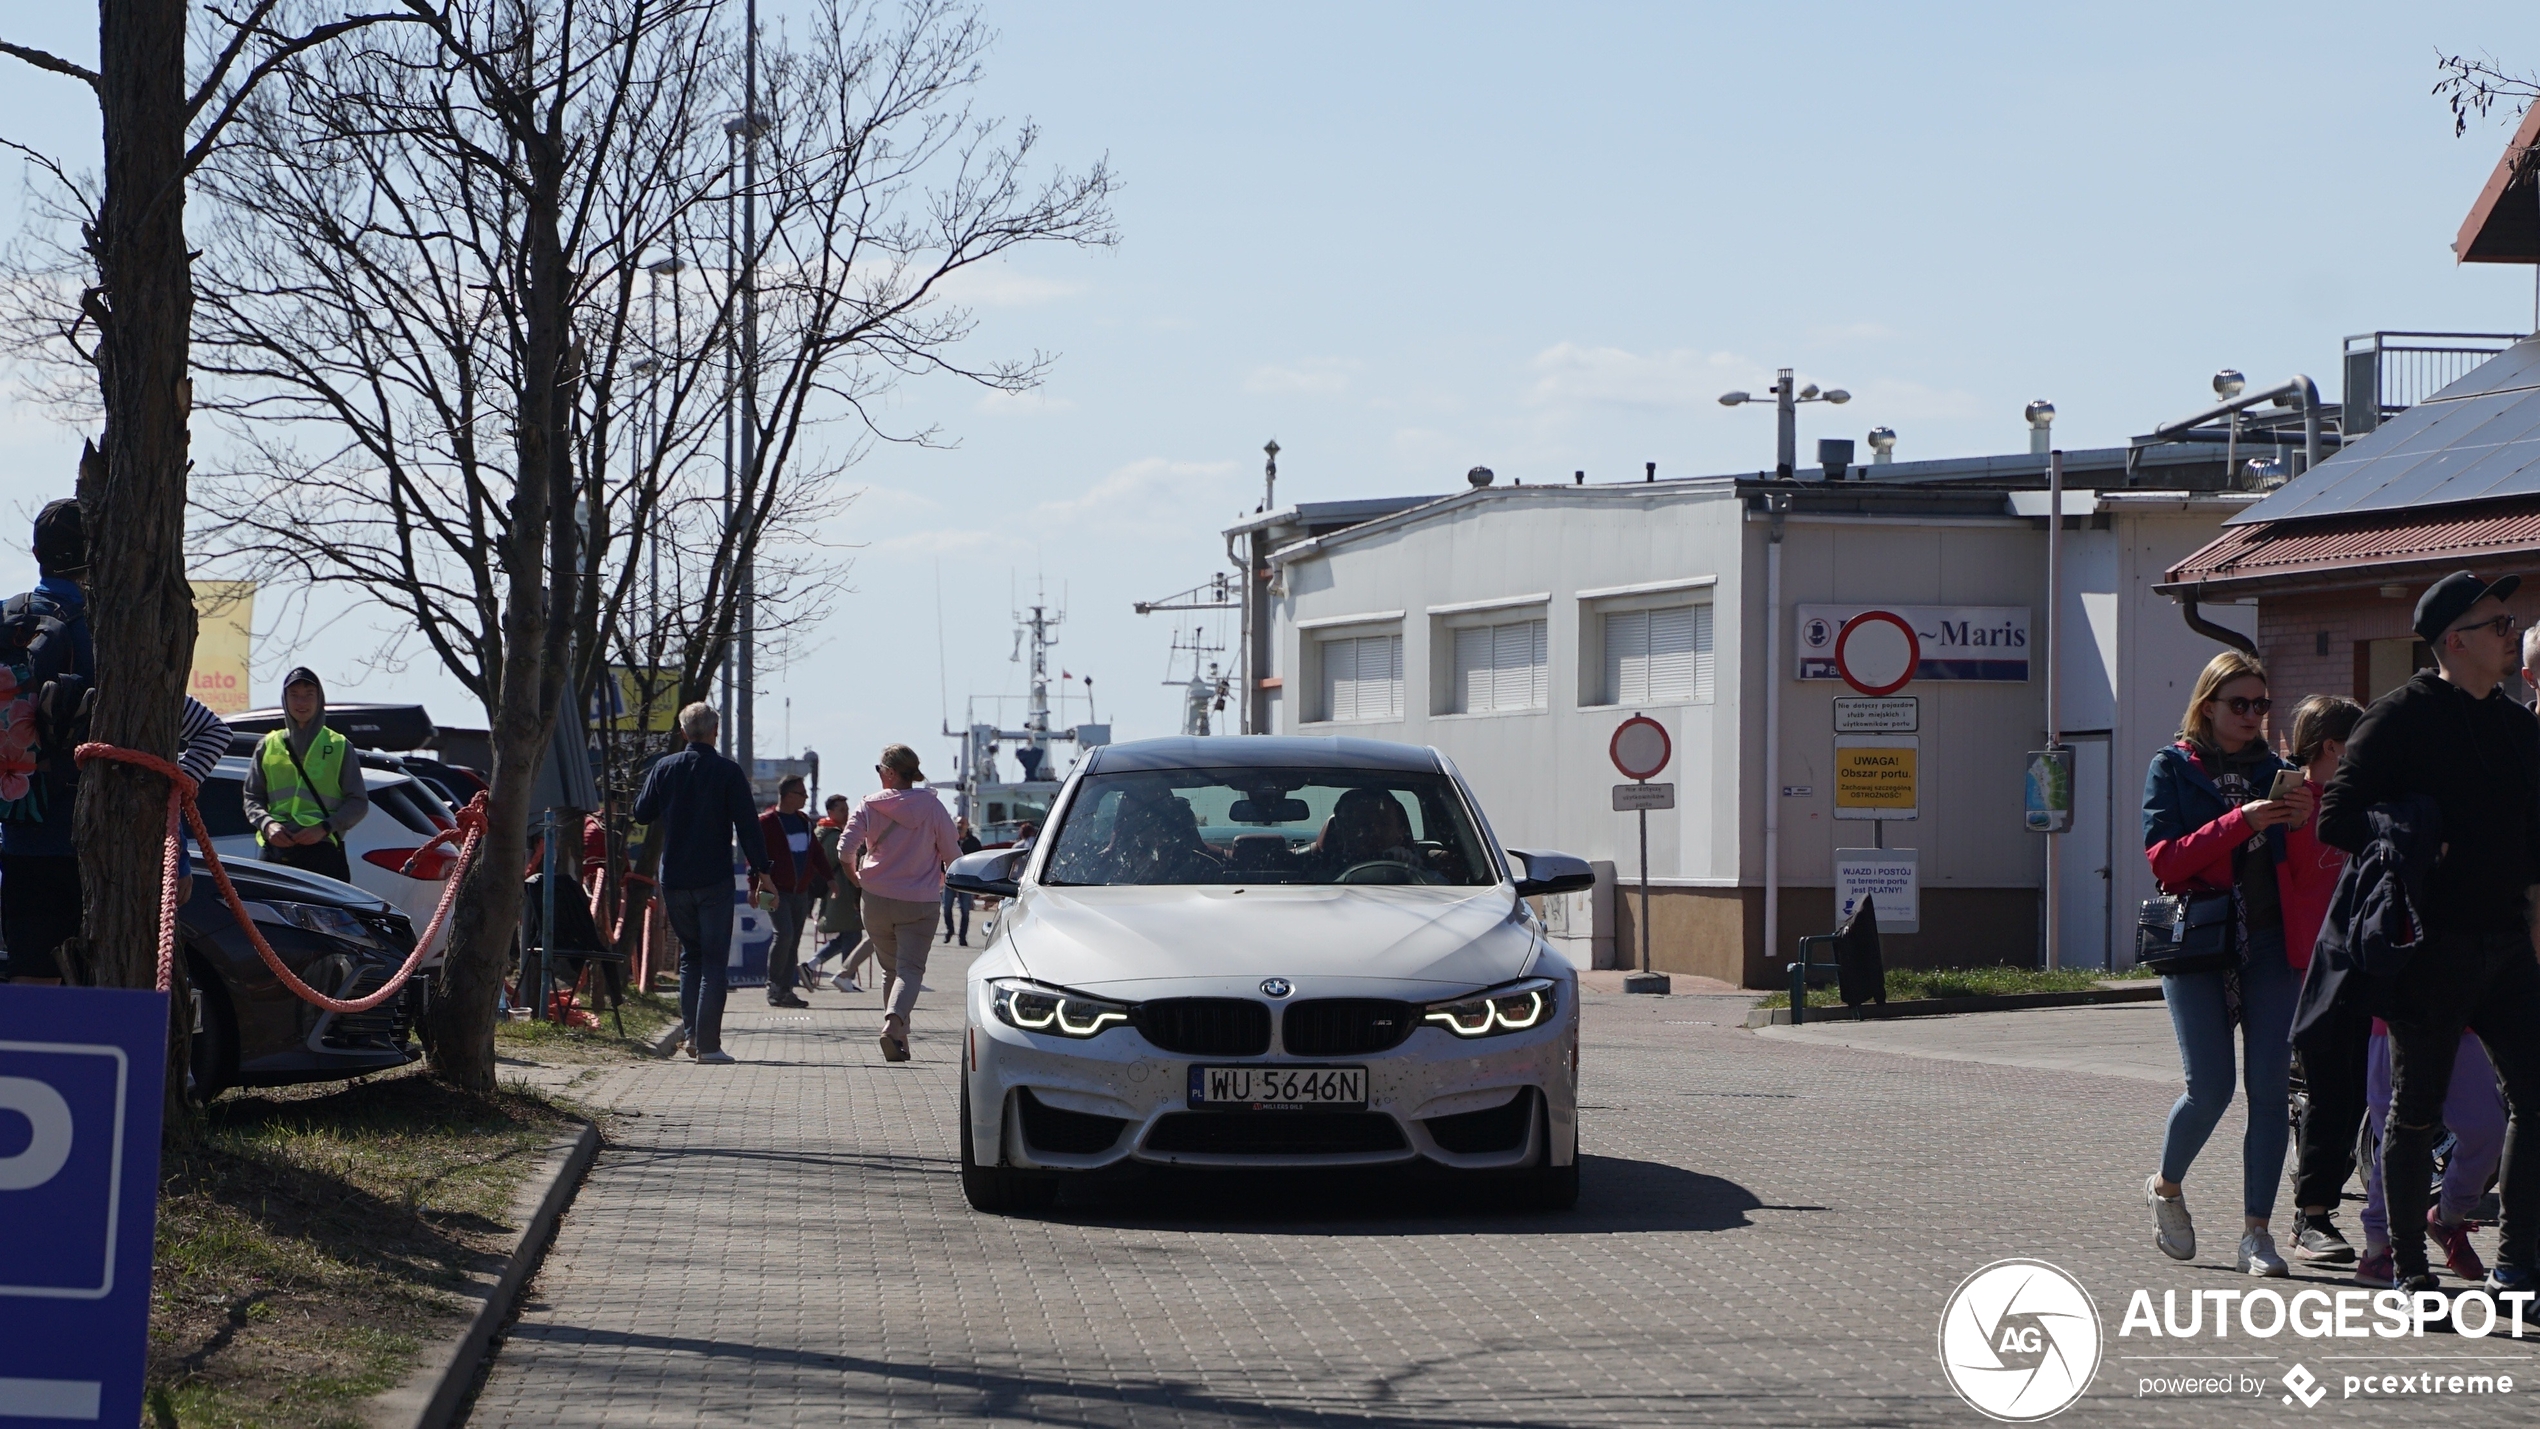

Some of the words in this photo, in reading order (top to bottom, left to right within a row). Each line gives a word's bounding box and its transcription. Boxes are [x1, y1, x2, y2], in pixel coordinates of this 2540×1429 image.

[193, 670, 237, 689] lato
[1853, 702, 1878, 710] dotyczy
[1881, 701, 1914, 710] pojazdów
[1868, 711, 1900, 719] miejskich
[1891, 721, 1910, 729] portu
[322, 745, 334, 760] P
[1854, 756, 1899, 766] UWAGA!
[1841, 768, 1878, 778] Obszar
[1881, 769, 1912, 780] portu.
[1840, 784, 1873, 792] Zachowaj
[1842, 867, 1872, 876] WJAZD
[1878, 866, 1912, 876] POSTÓJ
[1857, 877, 1885, 885] terenie
[1886, 878, 1908, 886] portu
[1851, 886, 1866, 895] jest
[1867, 886, 1902, 894] PŁATNY!
[1211, 1071, 1251, 1100] WU
[1262, 1071, 1358, 1101] 5646N
[1192, 1089, 1203, 1098] PL
